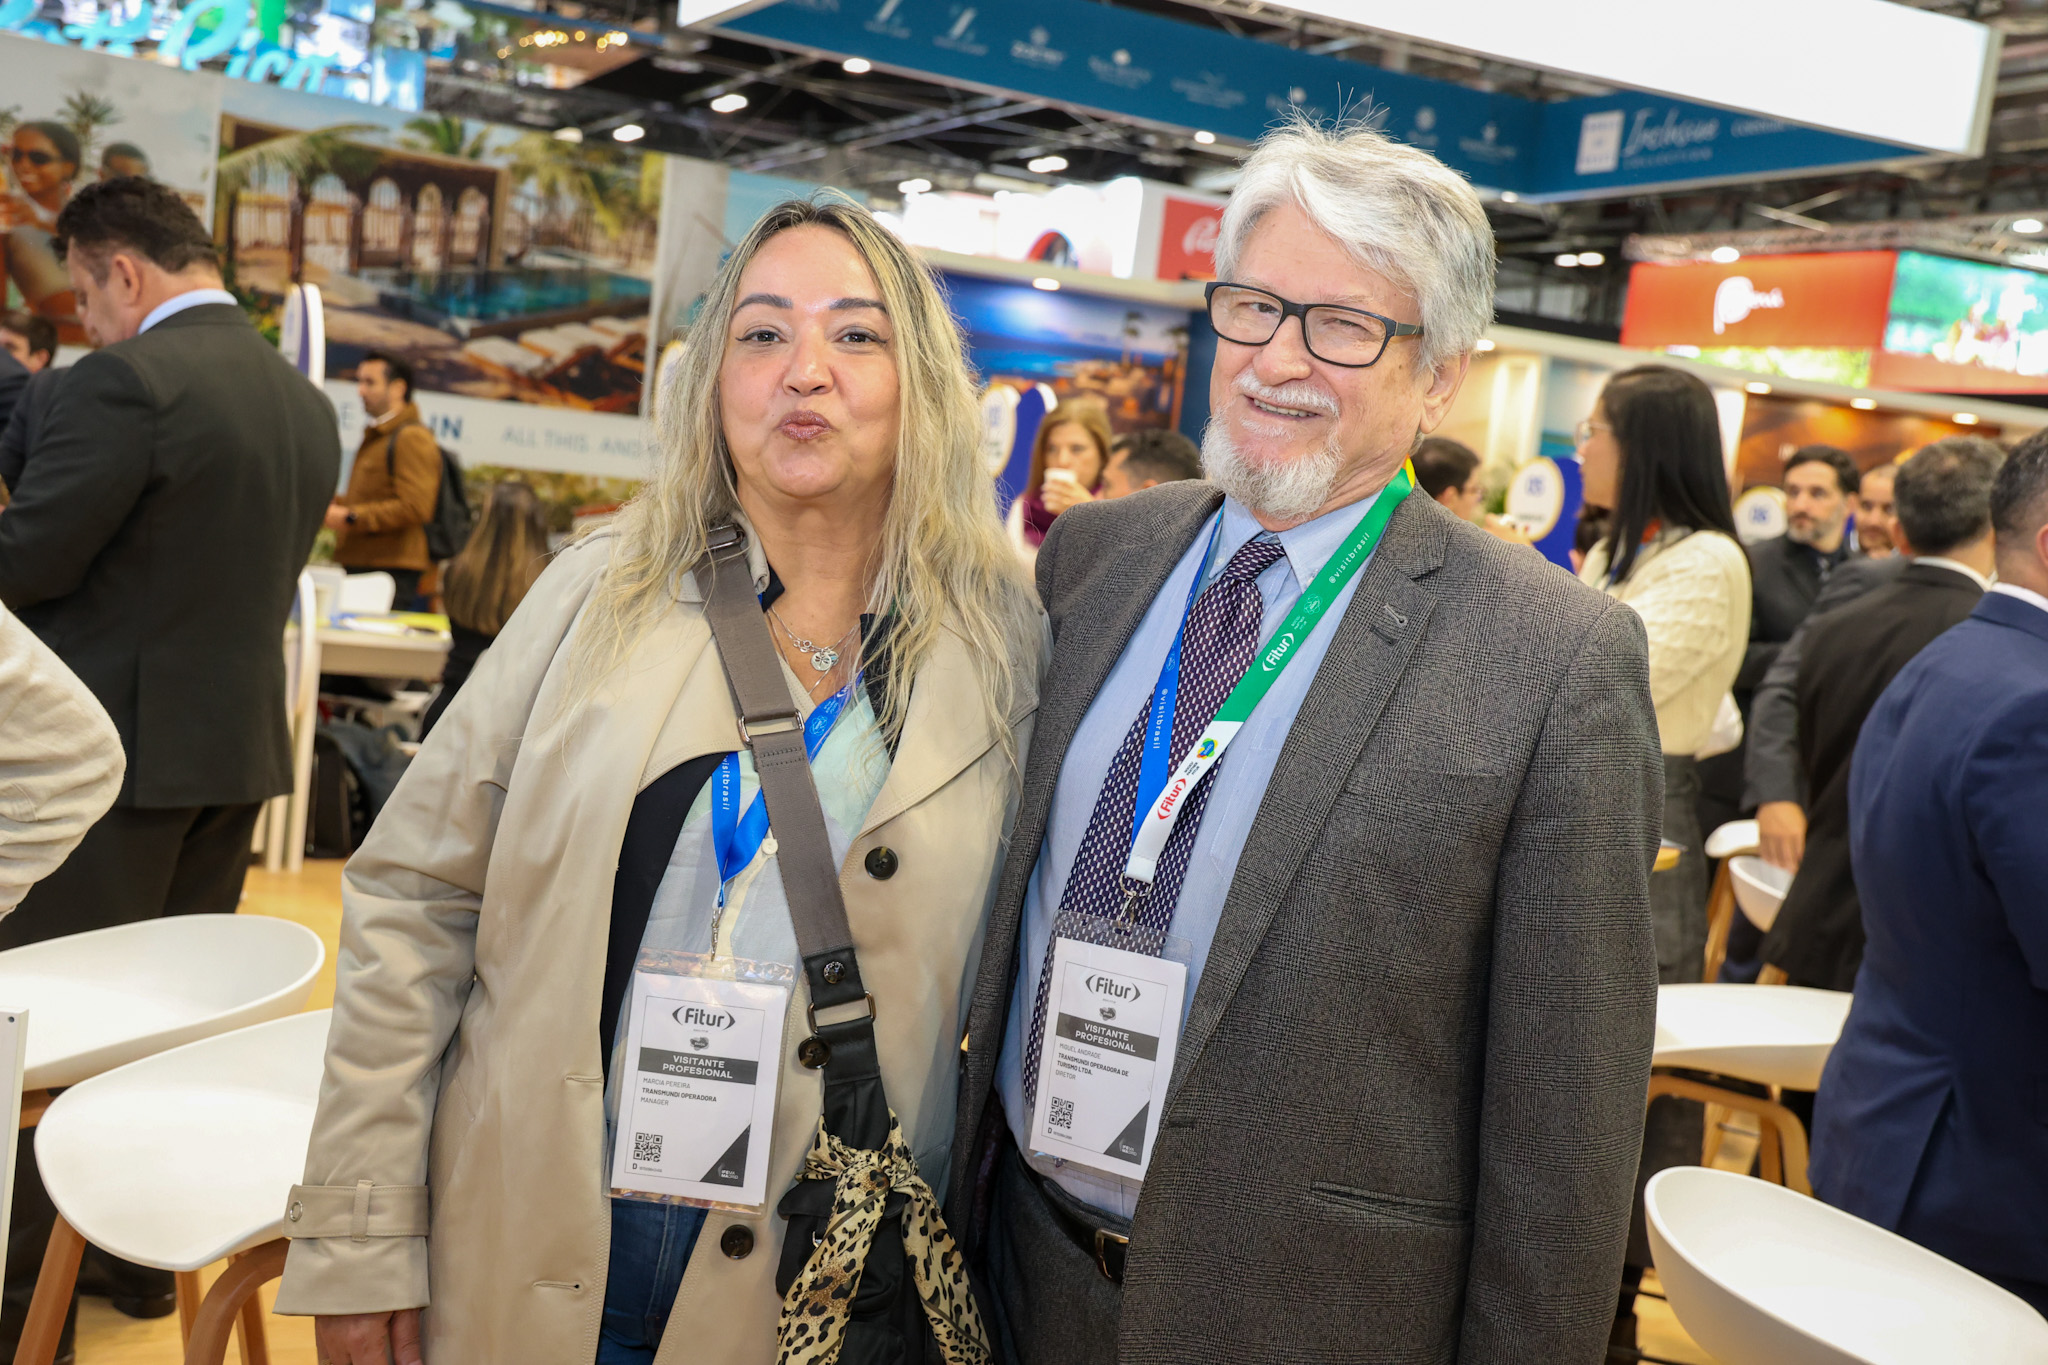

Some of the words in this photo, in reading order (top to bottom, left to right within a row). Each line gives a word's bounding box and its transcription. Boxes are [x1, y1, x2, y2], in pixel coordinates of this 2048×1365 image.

[1328, 532, 1371, 584] @visitbrasil
[1153, 688, 1169, 749] @visitbrasil
[722, 755, 730, 811] visitbrasil
[1084, 1022, 1130, 1041] VISITANTE
[1075, 1030, 1136, 1053] PROFESIONAL
[1059, 1043, 1078, 1054] MIGUEL
[1077, 1048, 1101, 1060] ANDRADE
[673, 1055, 726, 1069] VISITANTE
[1057, 1060, 1078, 1072] TURISMO
[1078, 1066, 1093, 1076] LTDA.
[1058, 1052, 1090, 1067] TRANSMUNDI
[1089, 1061, 1121, 1075] OPERADORA
[1121, 1068, 1129, 1077] DE
[662, 1063, 734, 1079] PROFESIONAL
[1055, 1070, 1077, 1081] DIRETOR
[643, 1077, 665, 1087] MARCIA
[665, 1080, 691, 1090] PEREIRA
[640, 1096, 669, 1106] MANAGER
[642, 1087, 681, 1098] TRANSMUNDI
[680, 1091, 717, 1102] OPERADORA
